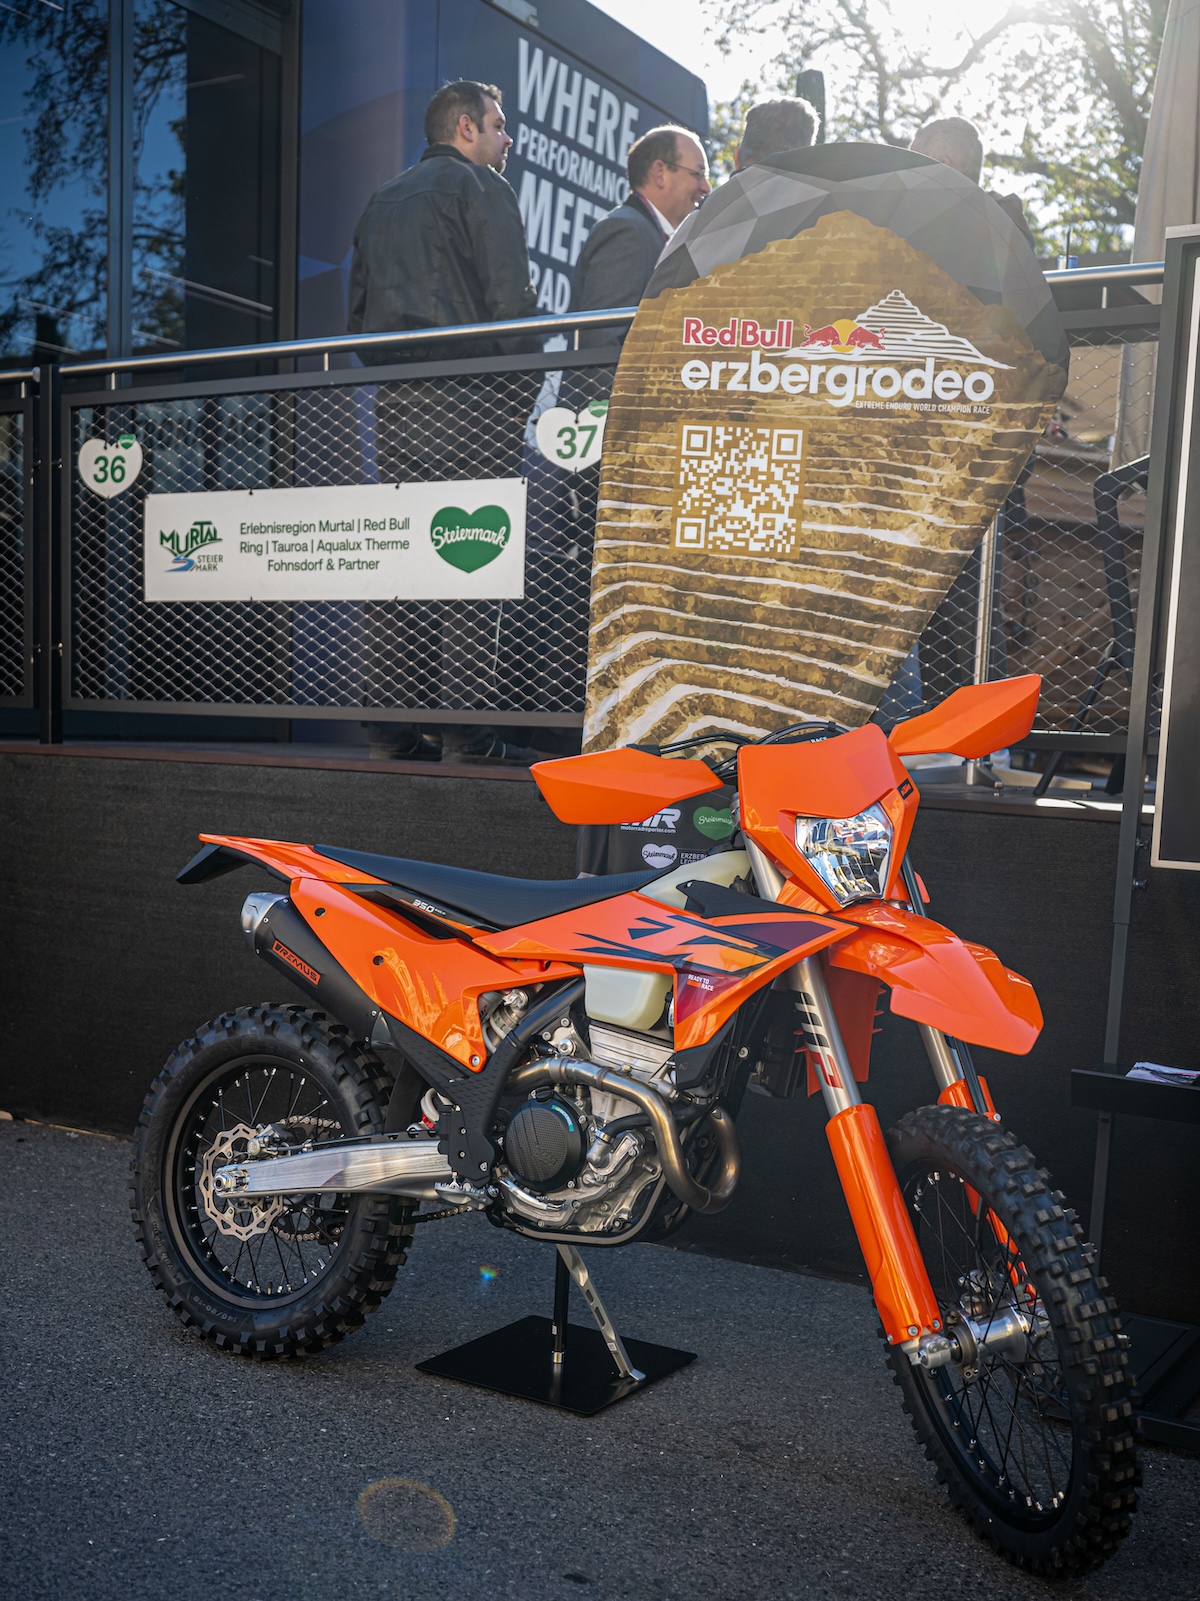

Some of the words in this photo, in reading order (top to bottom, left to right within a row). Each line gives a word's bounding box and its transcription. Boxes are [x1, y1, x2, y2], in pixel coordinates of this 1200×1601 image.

[518, 37, 639, 168] WHERE
[516, 123, 631, 204] PERFORMANC
[519, 170, 608, 267] MEE
[683, 316, 739, 347] Red
[740, 317, 794, 349] Bull
[680, 350, 995, 408] erzbergrodeo
[855, 400, 884, 411] EXTREME
[886, 401, 912, 412] ENDURO
[913, 402, 936, 412] WORLD
[937, 402, 971, 414] CHAMPION
[973, 404, 990, 414] RACE
[556, 425, 598, 460] 37
[93, 455, 126, 484] 36
[159, 519, 221, 556] MURTAL
[240, 520, 316, 536] Erlebnisregion
[318, 520, 355, 533] Murtal
[363, 519, 386, 532] Red
[388, 518, 410, 531] Bull
[432, 525, 509, 547] Steiermark
[240, 540, 263, 556] Ring
[272, 540, 309, 553] Tauroa
[317, 538, 362, 554] Aqualux
[365, 537, 410, 552] Therme
[195, 564, 217, 573] MARK
[197, 554, 223, 564] STEIER
[267, 559, 323, 573] Fohnsdorf
[326, 559, 335, 571] &
[338, 559, 380, 571] Partner
[413, 899, 435, 913] 350
[279, 949, 317, 982] REMUS
[688, 974, 702, 983] READY
[701, 983, 714, 991] RACE
